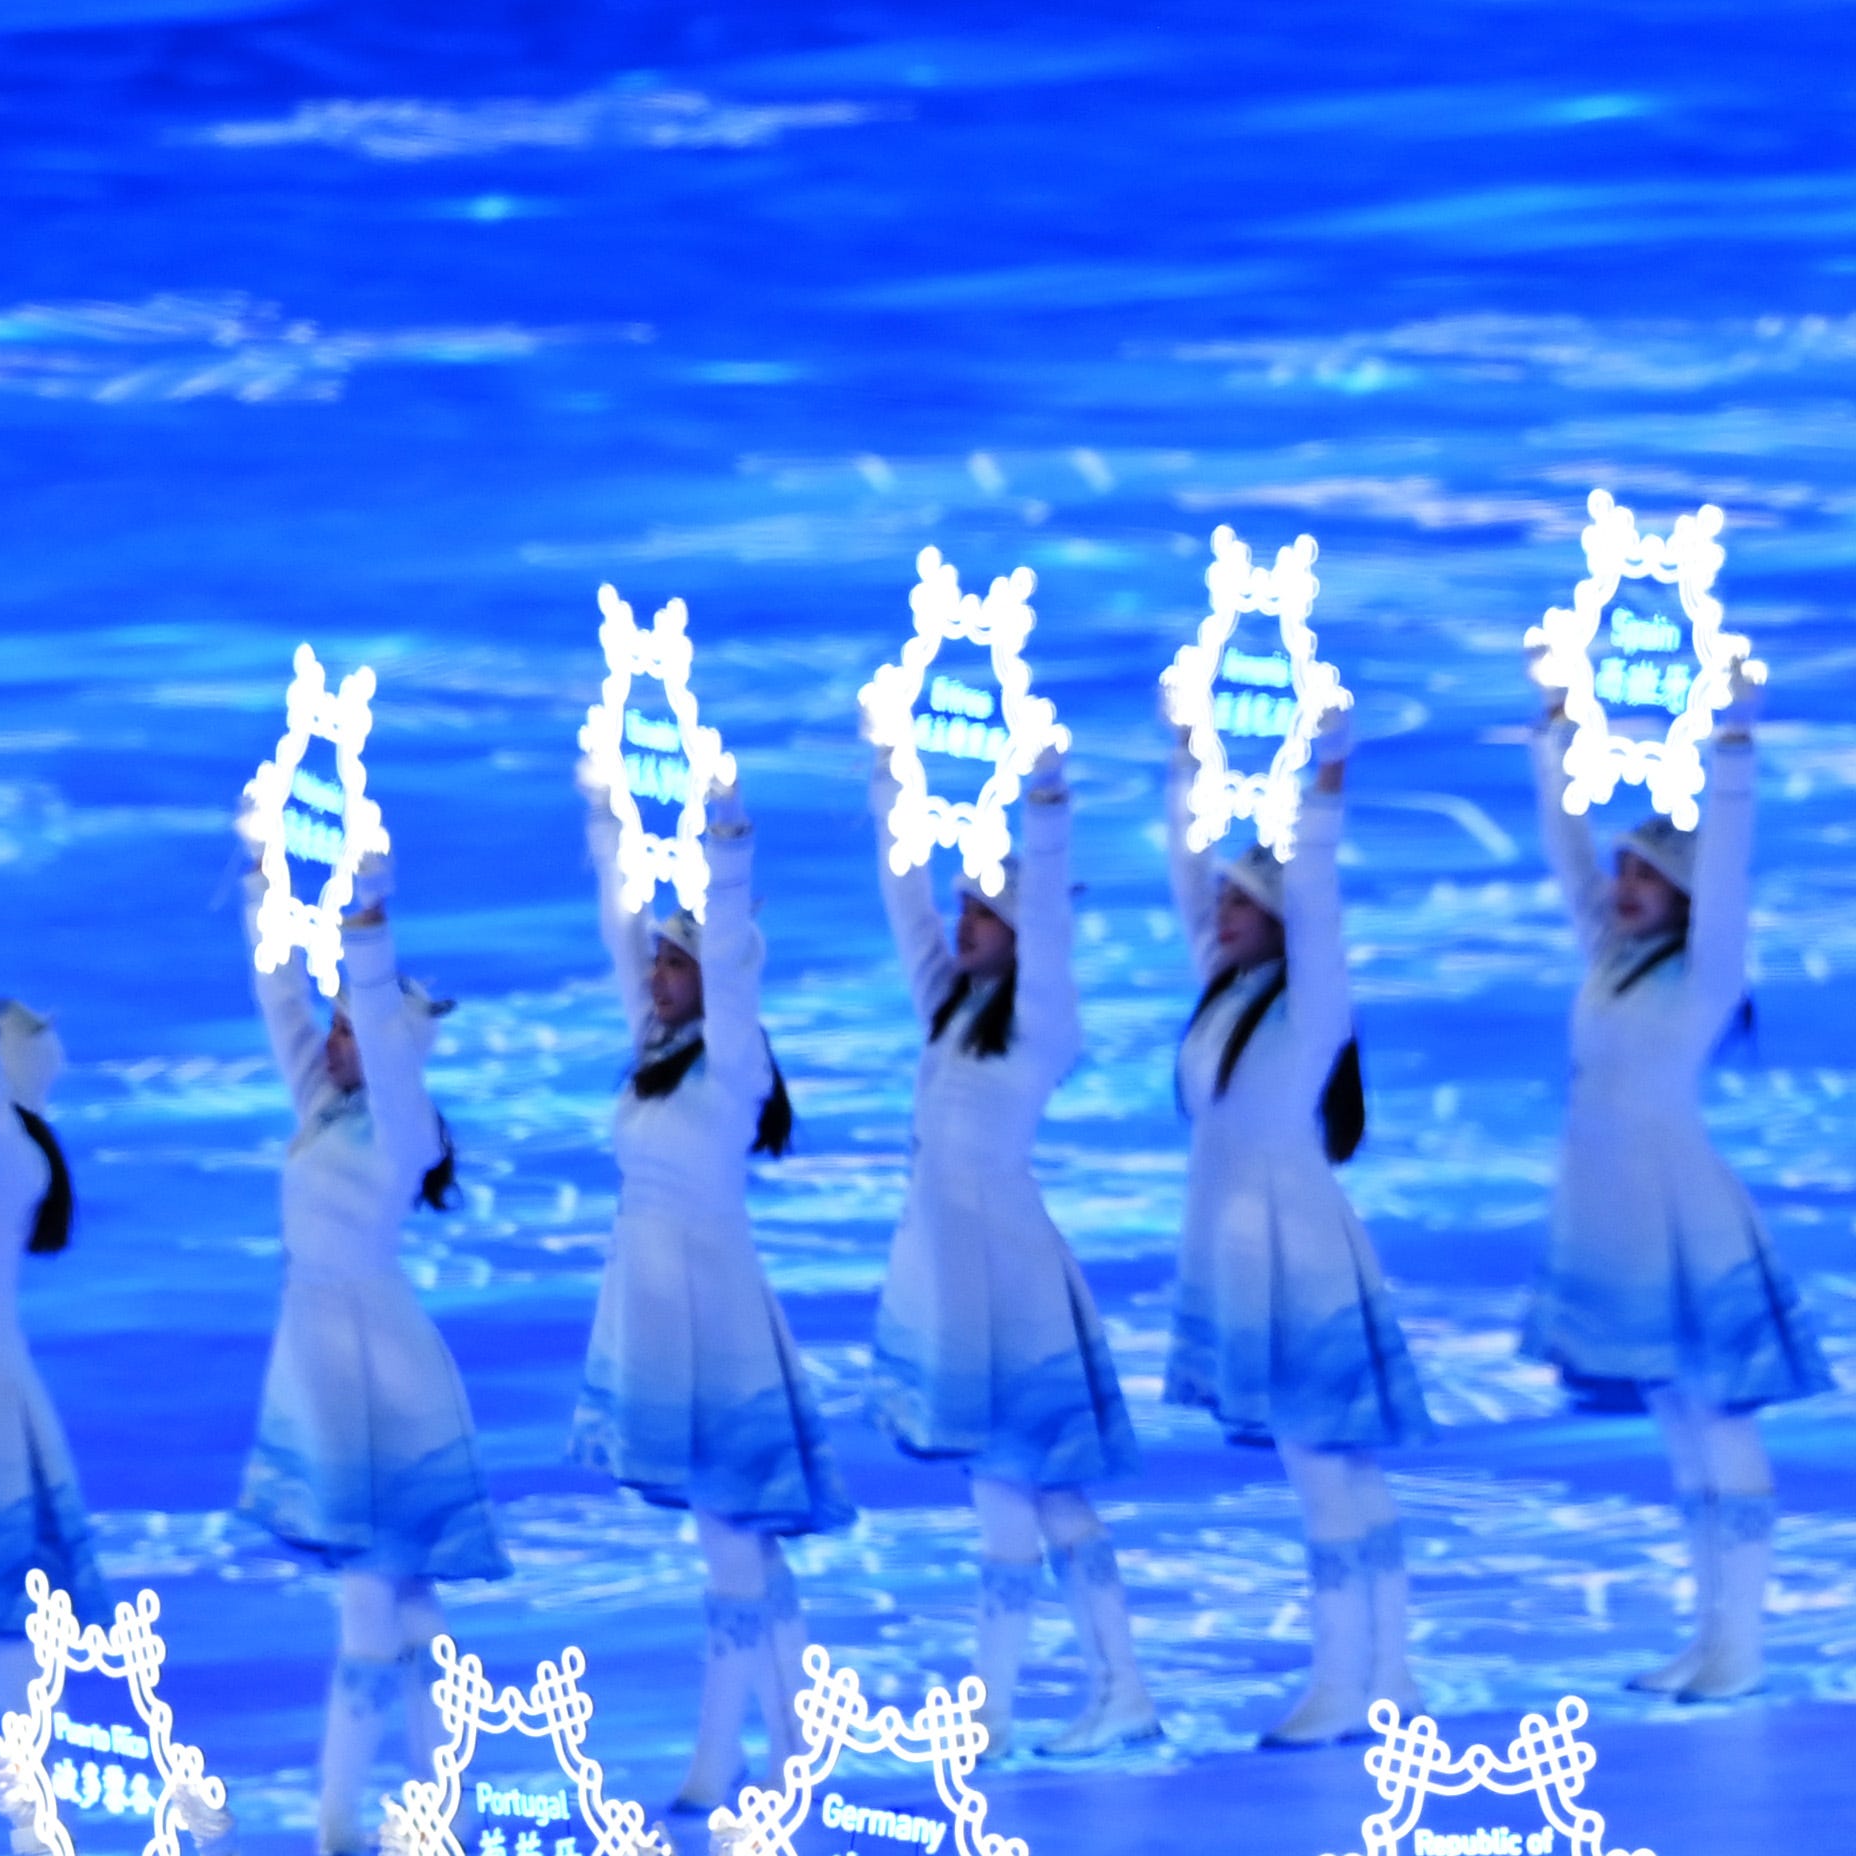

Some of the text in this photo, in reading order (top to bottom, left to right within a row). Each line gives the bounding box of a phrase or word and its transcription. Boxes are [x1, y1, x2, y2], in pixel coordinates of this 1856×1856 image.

[476, 1781, 571, 1827] Portugal
[822, 1792, 947, 1855] Germany
[1526, 1825, 1555, 1856] of
